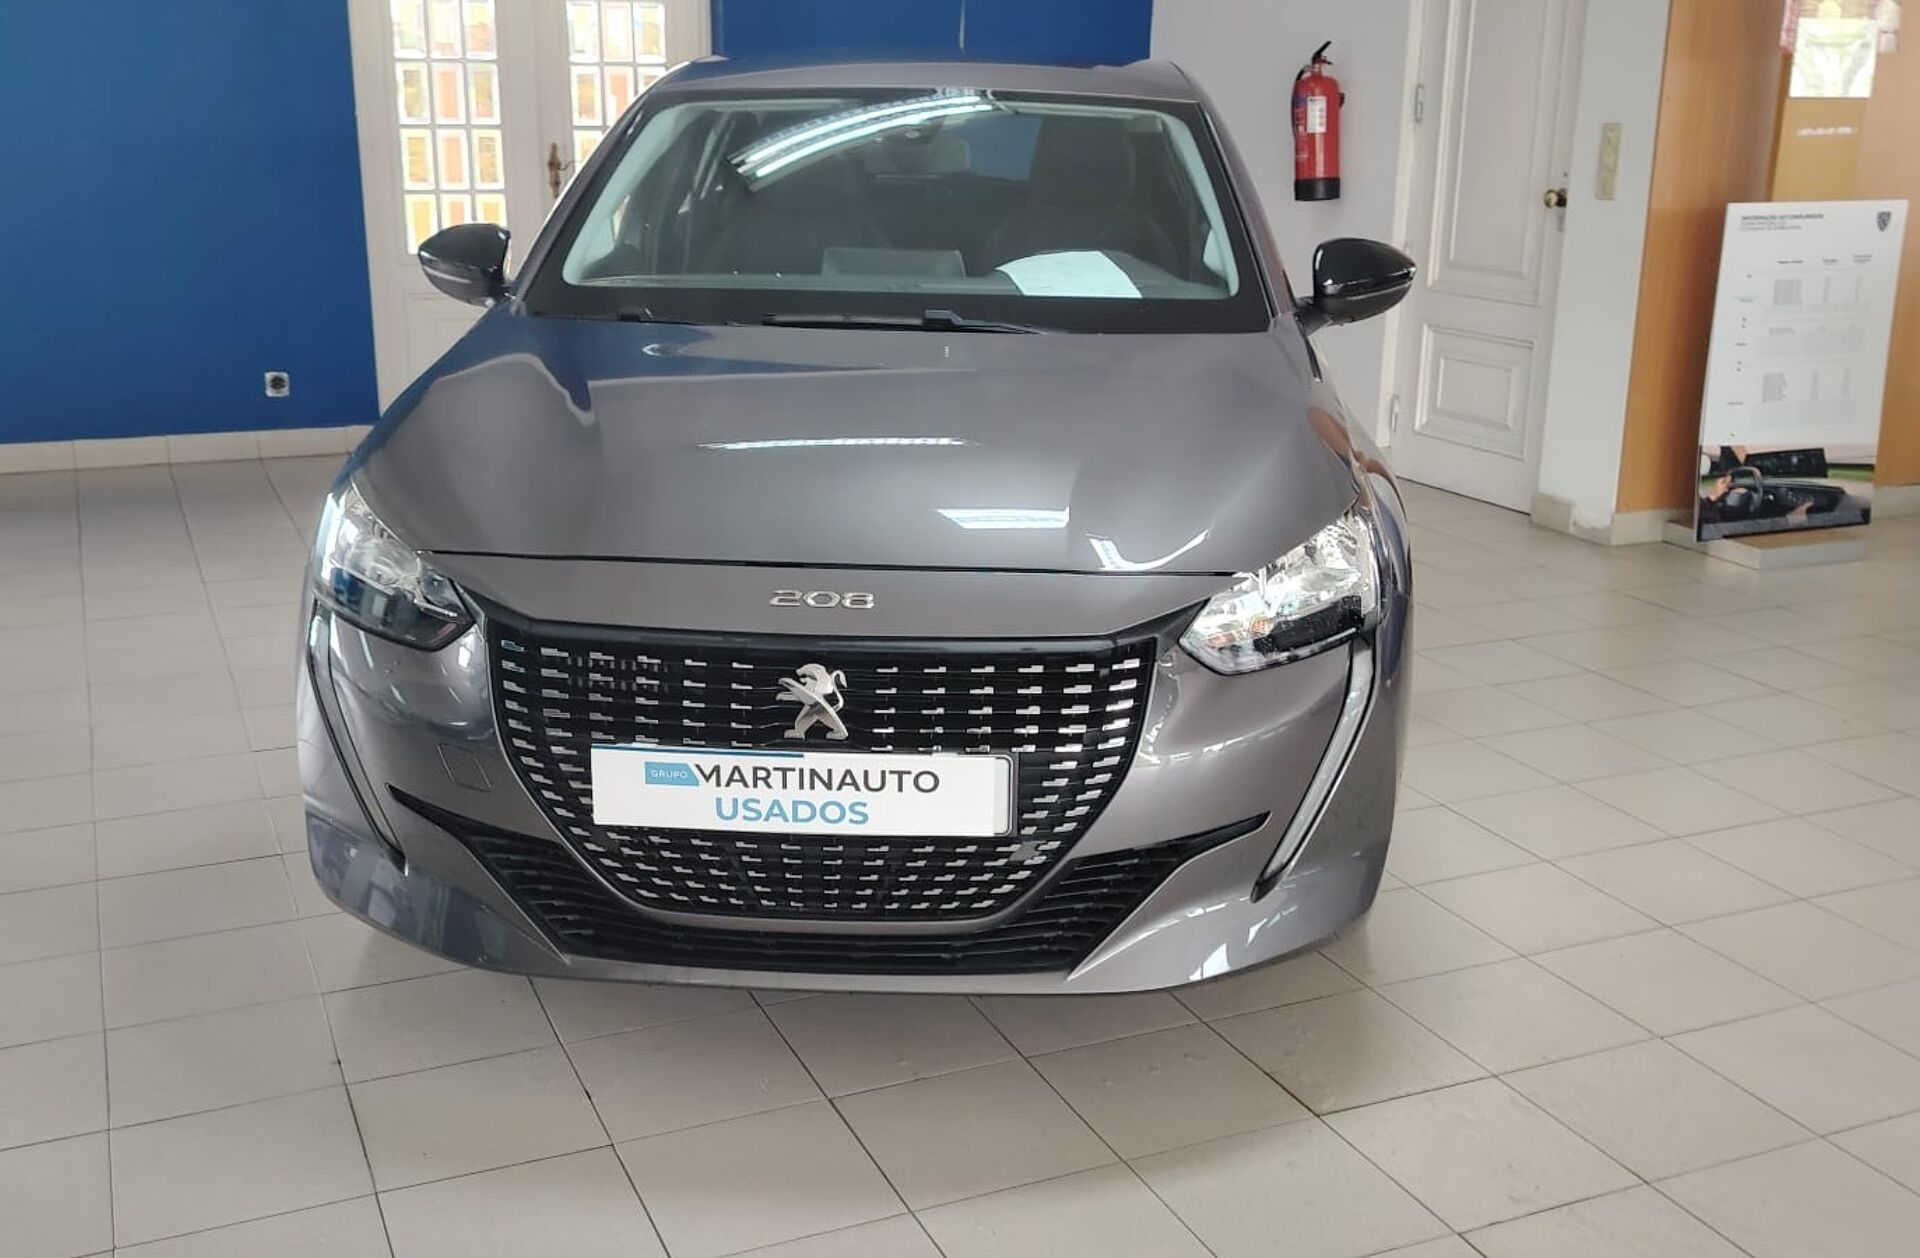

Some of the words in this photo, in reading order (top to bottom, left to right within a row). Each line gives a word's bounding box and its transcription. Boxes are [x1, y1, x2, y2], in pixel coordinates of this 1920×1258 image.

[769, 589, 875, 609] 208
[651, 769, 688, 780] GRUPO
[695, 763, 940, 793] MARTINAUTO
[715, 797, 870, 825] USADOS
